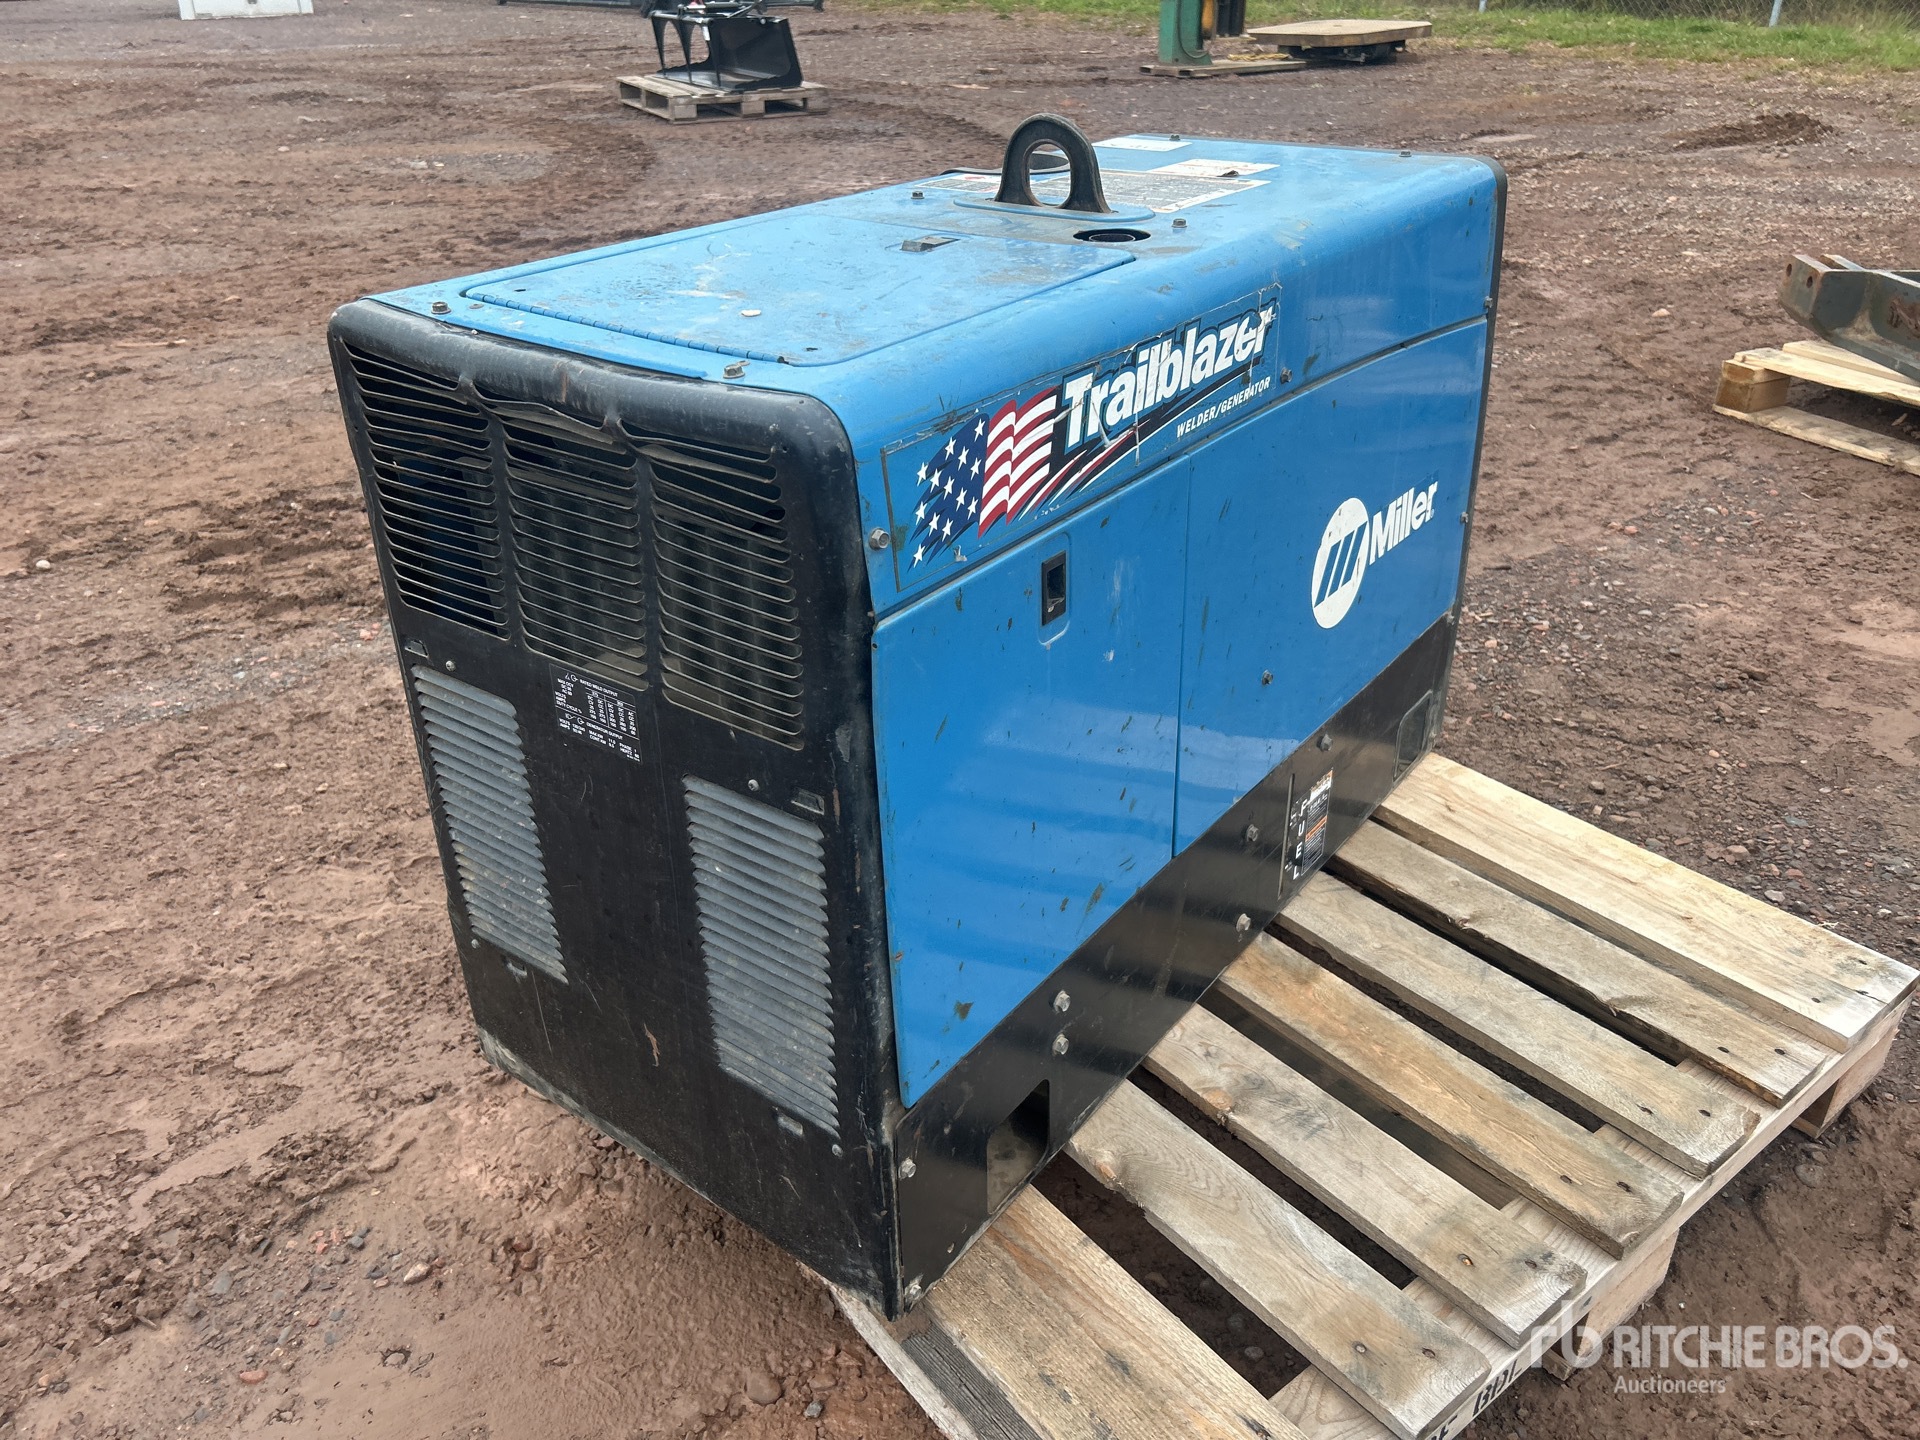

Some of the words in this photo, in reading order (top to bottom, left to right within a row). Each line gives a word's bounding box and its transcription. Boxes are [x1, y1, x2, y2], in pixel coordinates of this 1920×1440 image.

[1064, 304, 1275, 449] Trailblazer
[1176, 375, 1271, 439] WELDER/GENERATOR
[1369, 480, 1439, 566] Miller
[602, 688, 618, 697] OUTPUT
[608, 731, 623, 740] OUTPUT
